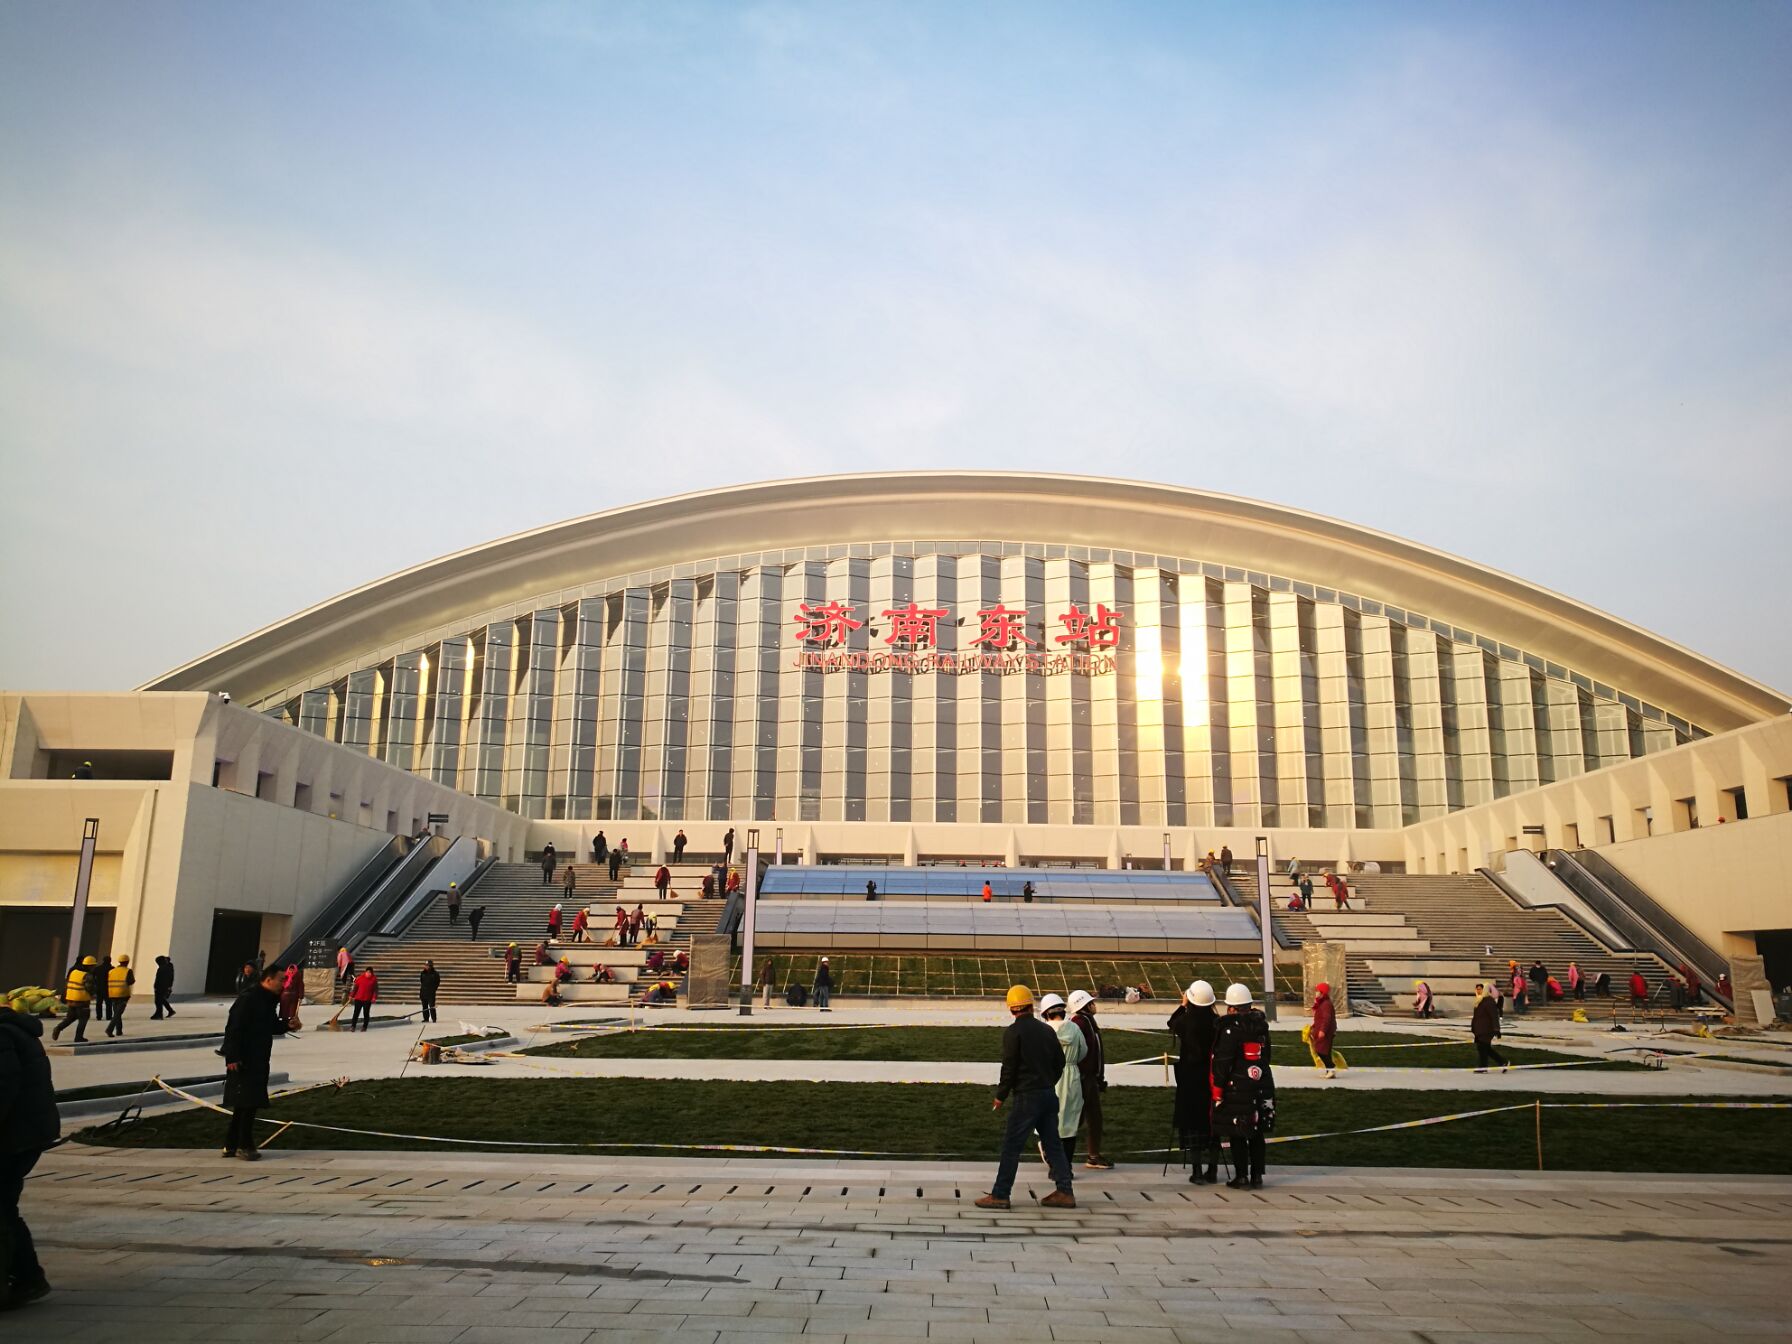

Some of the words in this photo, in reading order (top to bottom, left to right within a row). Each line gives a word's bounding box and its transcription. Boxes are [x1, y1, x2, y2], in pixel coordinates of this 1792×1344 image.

[793, 600, 1124, 648] 济南东站
[928, 652, 1022, 670] RAILWAY
[1025, 653, 1118, 671] STATION
